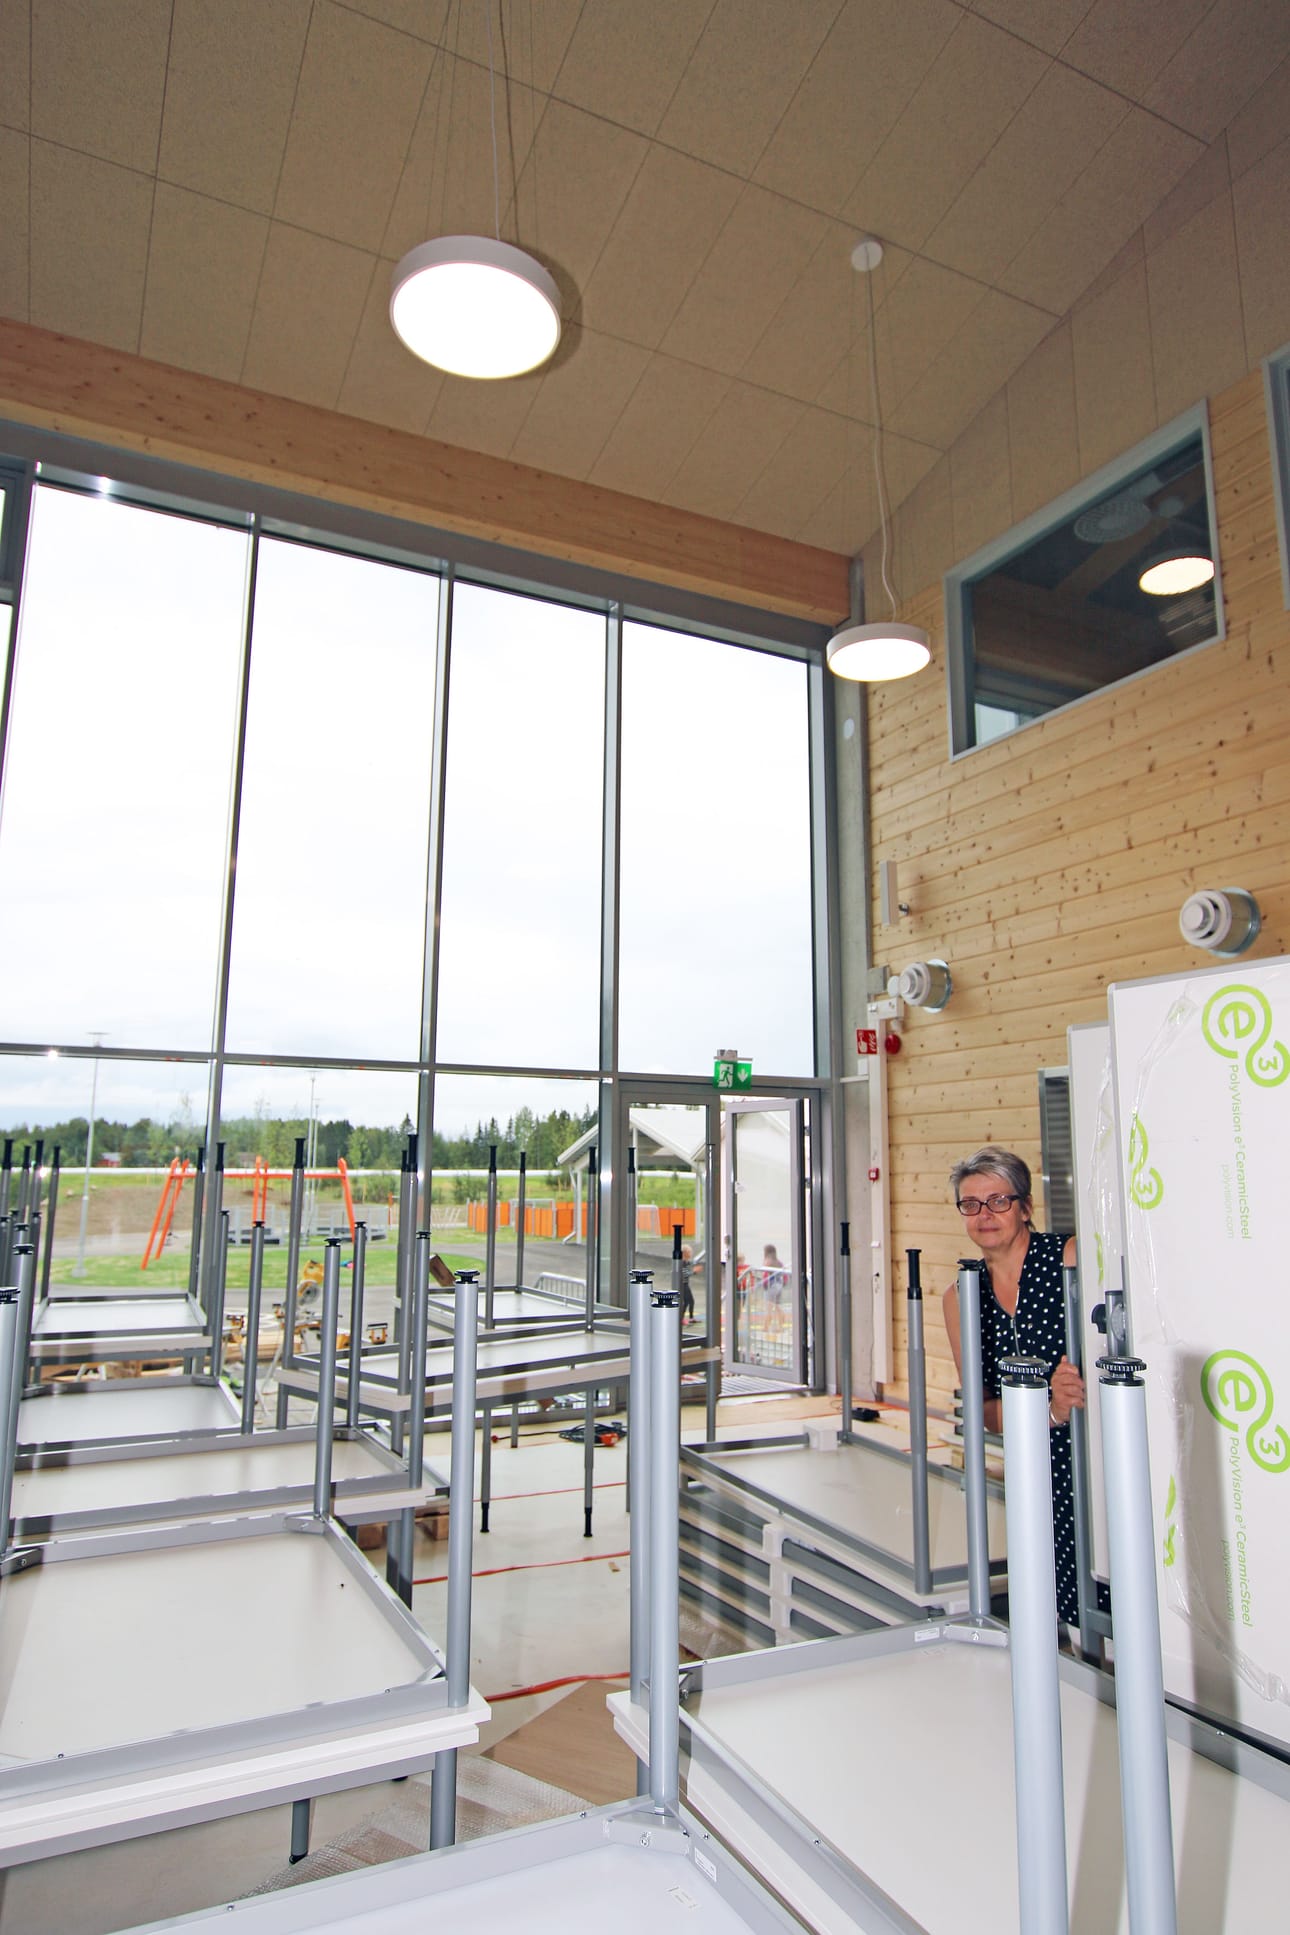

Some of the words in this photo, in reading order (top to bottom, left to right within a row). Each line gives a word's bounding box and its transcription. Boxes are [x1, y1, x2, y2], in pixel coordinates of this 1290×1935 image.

[1229, 1064, 1242, 1132] PolyVision
[1235, 1151, 1252, 1240] CeramicSteel
[1229, 1436, 1244, 1510] PolyVision
[1221, 1539, 1236, 1622] polyvision.com
[1236, 1531, 1254, 1627] CeramicSteel
